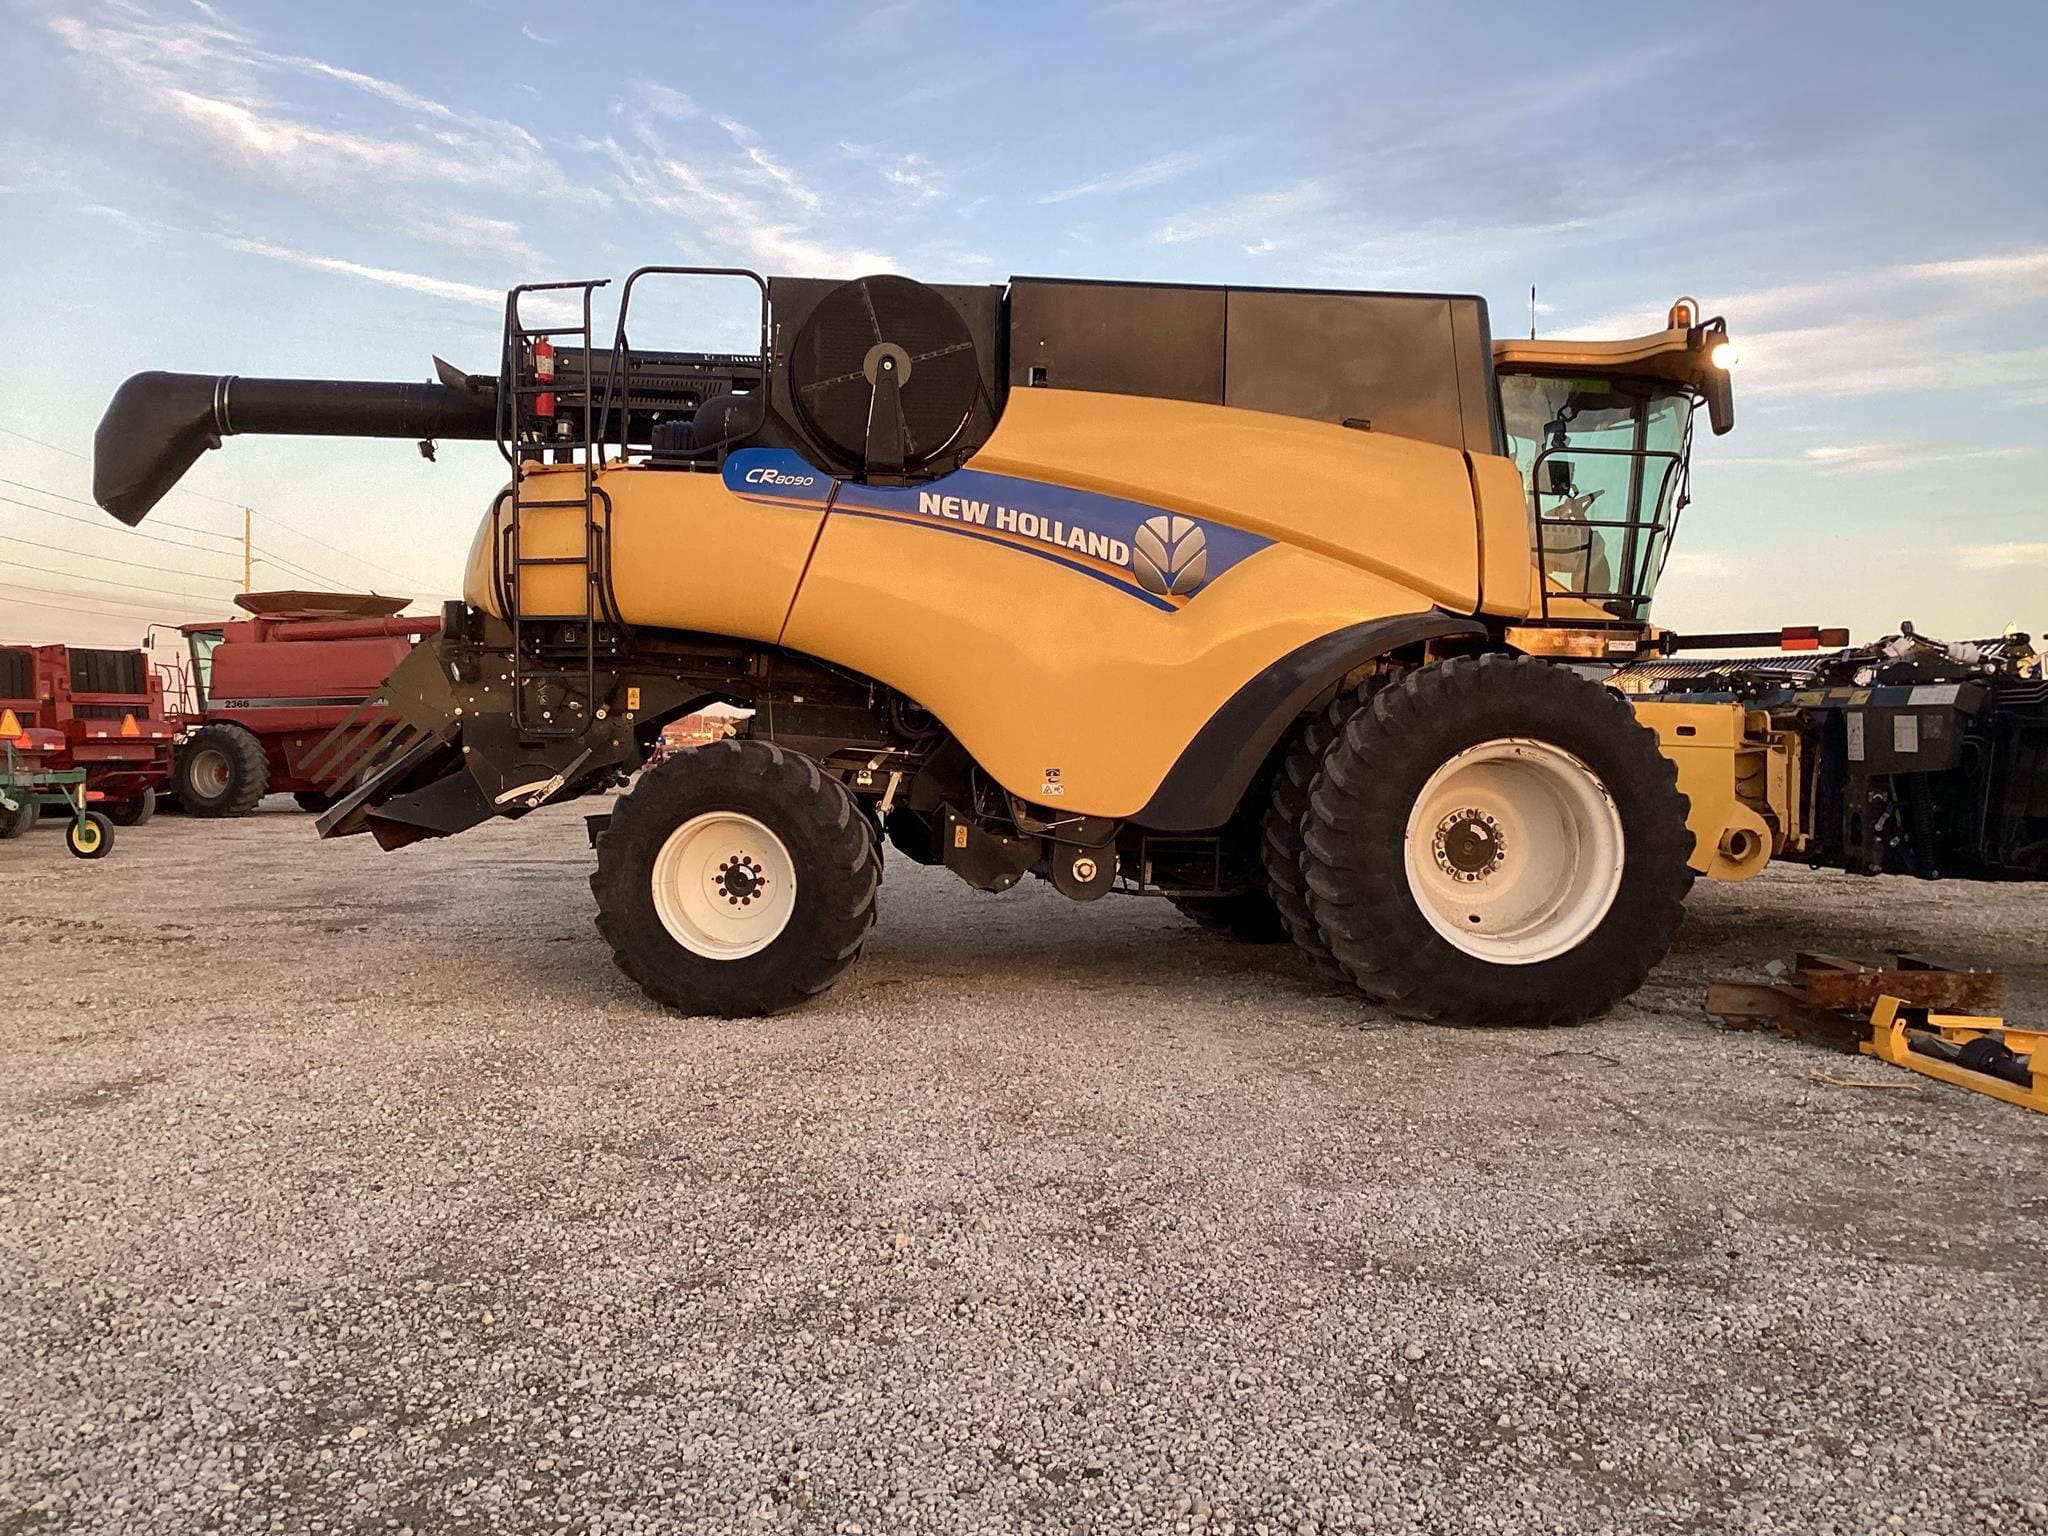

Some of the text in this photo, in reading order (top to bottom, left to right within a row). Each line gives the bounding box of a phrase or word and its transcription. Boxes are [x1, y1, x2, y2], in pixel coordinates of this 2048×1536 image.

[745, 468, 814, 486] CR8090
[918, 491, 1130, 566] NEW HOLLAND
[224, 700, 250, 708] 2366
